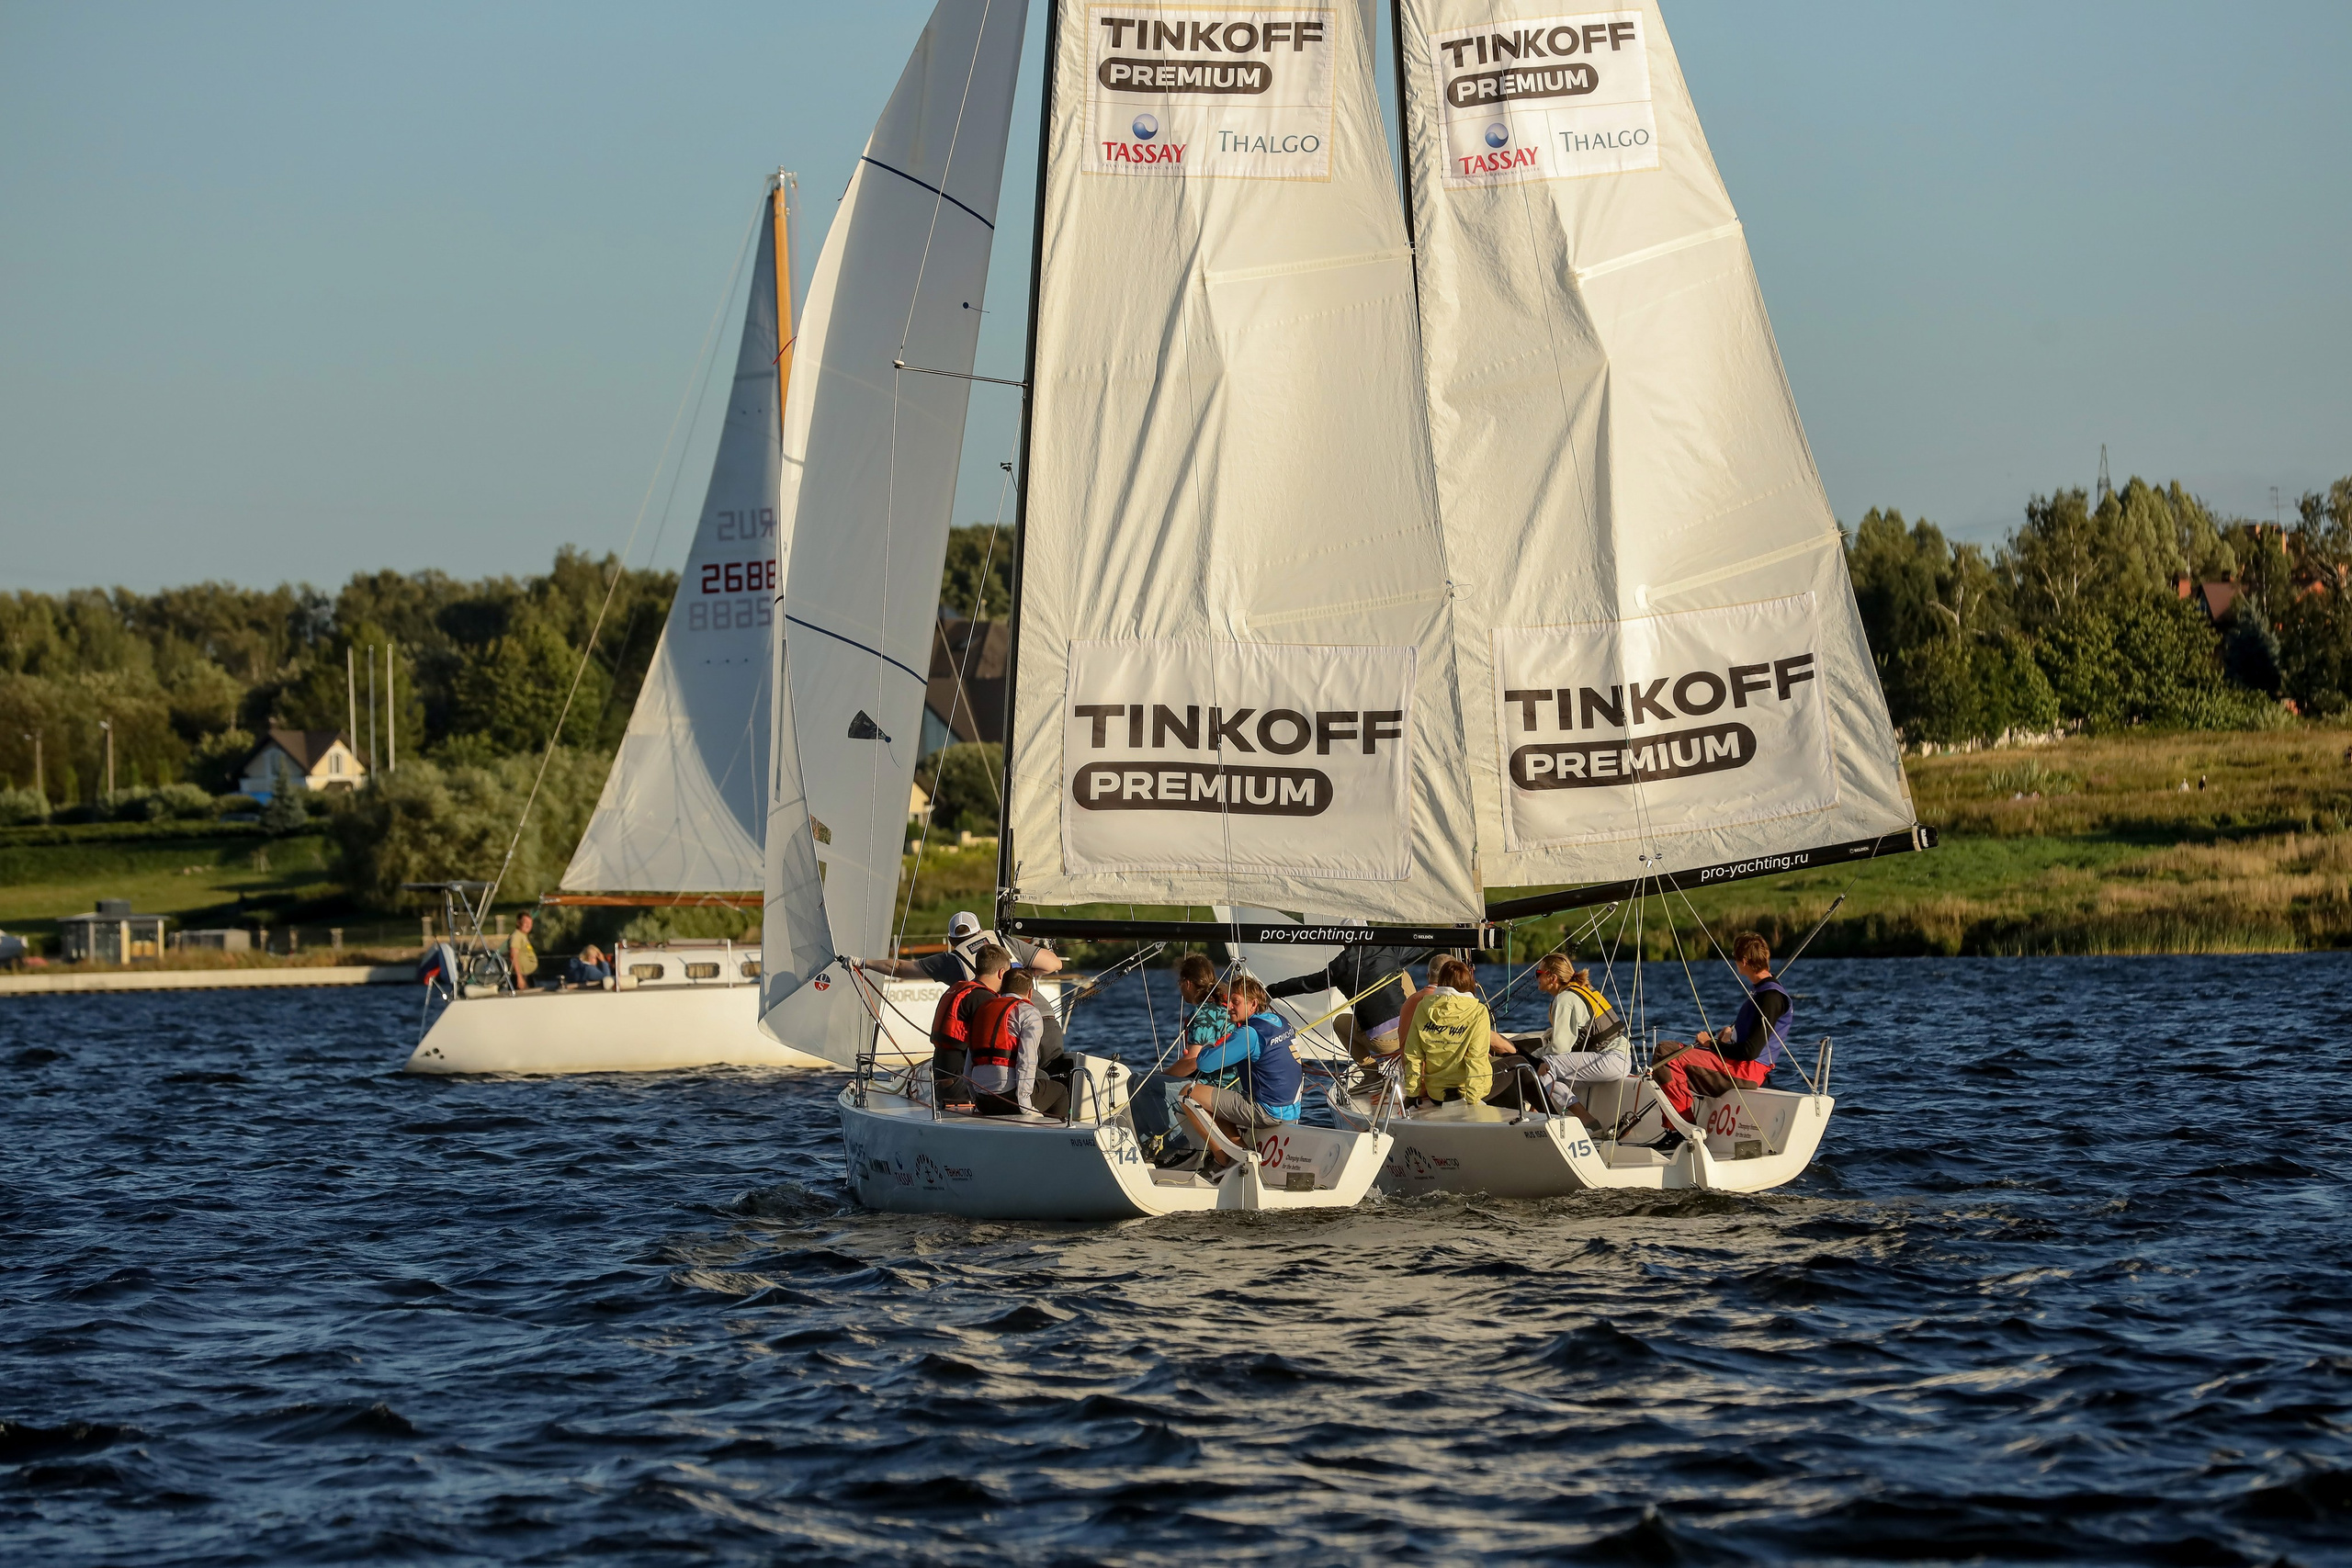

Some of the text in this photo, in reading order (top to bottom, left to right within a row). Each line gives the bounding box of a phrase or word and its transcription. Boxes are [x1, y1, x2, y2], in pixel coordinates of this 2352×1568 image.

[1101, 17, 1324, 53] TINKOFF
[1441, 21, 1636, 69] TINKOFF
[1109, 63, 1261, 88] PREMIUM
[1456, 69, 1589, 102] PREMIUM
[1102, 141, 1187, 164] TASSAY
[1218, 130, 1320, 153] THALGO
[1559, 129, 1649, 152] THALGO
[1458, 146, 1539, 175] TASSAY
[1504, 652, 1815, 732] TINKOFF
[1074, 705, 1403, 756] TINKOFF
[1524, 731, 1741, 782] PREMIUM
[1090, 772, 1316, 807] PREMIUM
[1701, 853, 1809, 882] pro-yachting.ru
[1260, 928, 1374, 943] pro-yachting.ru
[1422, 1021, 1468, 1038] HARD WAY
[1070, 1138, 1083, 1146] RUS
[1114, 1146, 1138, 1165] 14
[1567, 1139, 1591, 1158] 15
